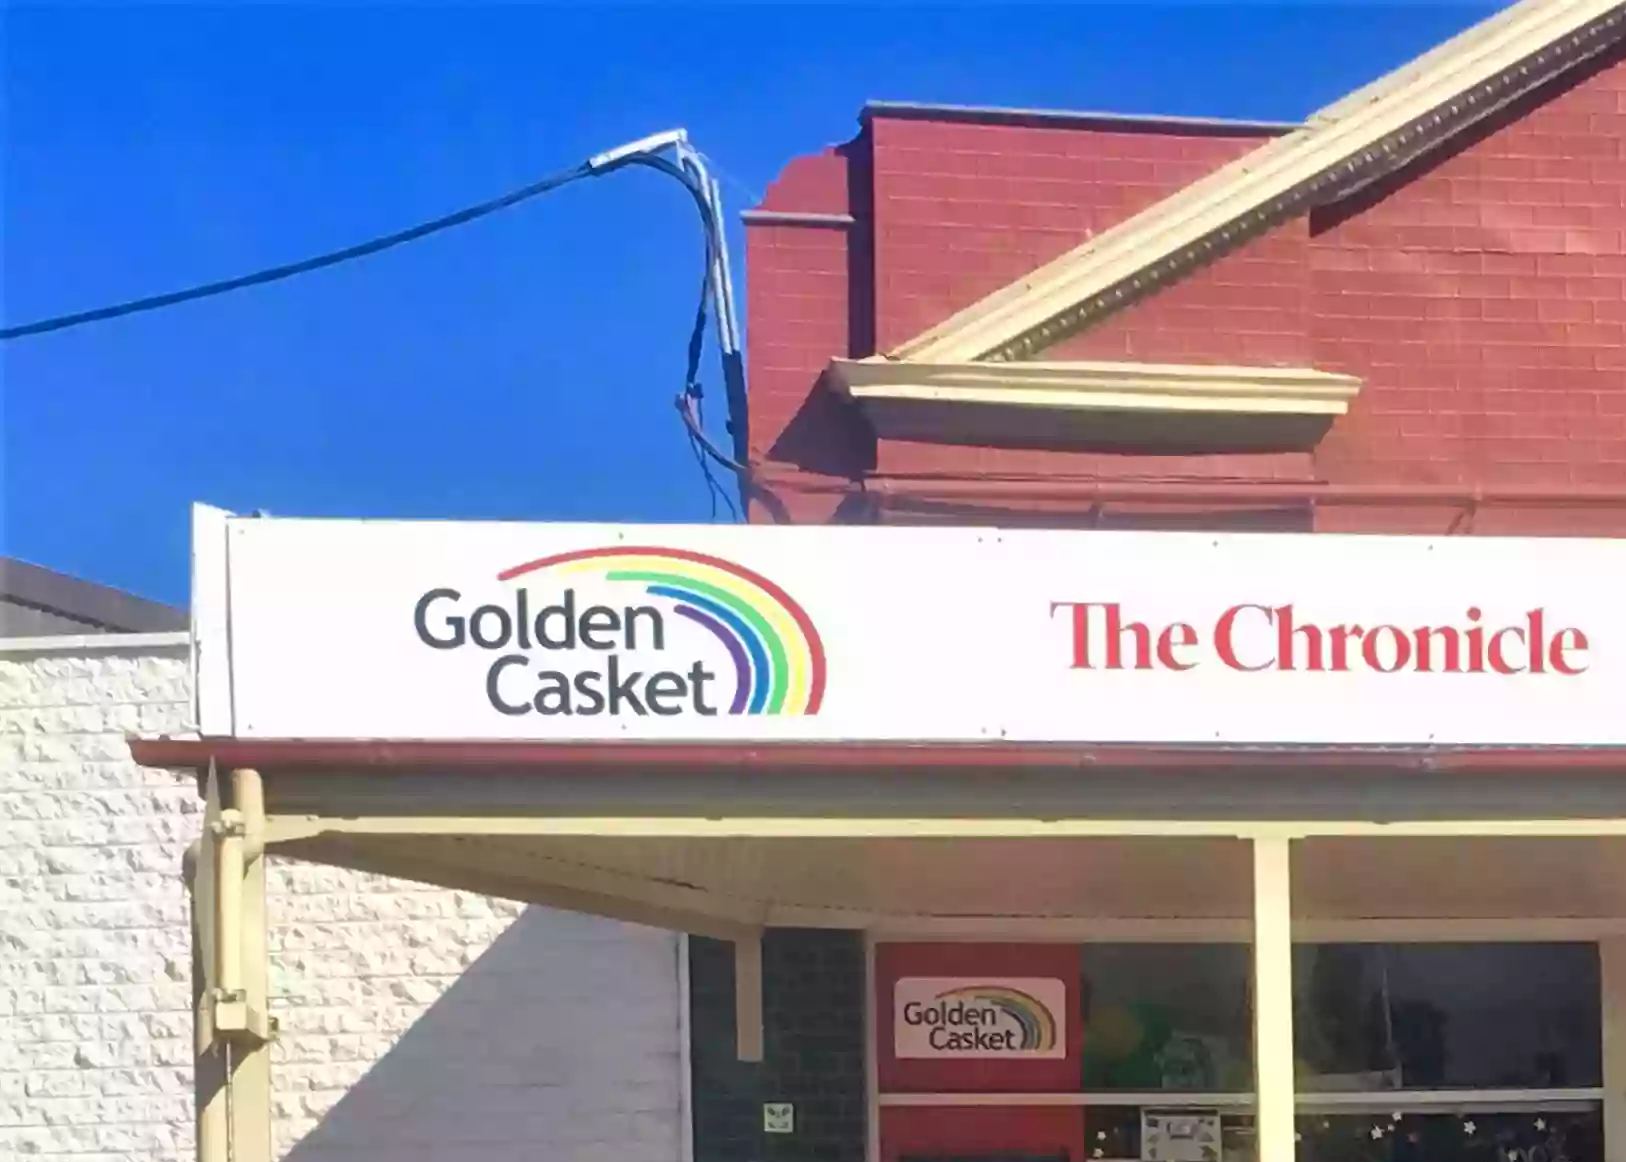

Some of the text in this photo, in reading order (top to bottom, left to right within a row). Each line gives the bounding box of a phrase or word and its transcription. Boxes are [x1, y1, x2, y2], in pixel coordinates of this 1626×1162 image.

[414, 586, 665, 650] Golden
[1049, 601, 1589, 676] The Chronicle
[487, 654, 717, 715] Casket
[903, 1001, 997, 1026] Golden
[928, 1027, 1017, 1051] Casket
